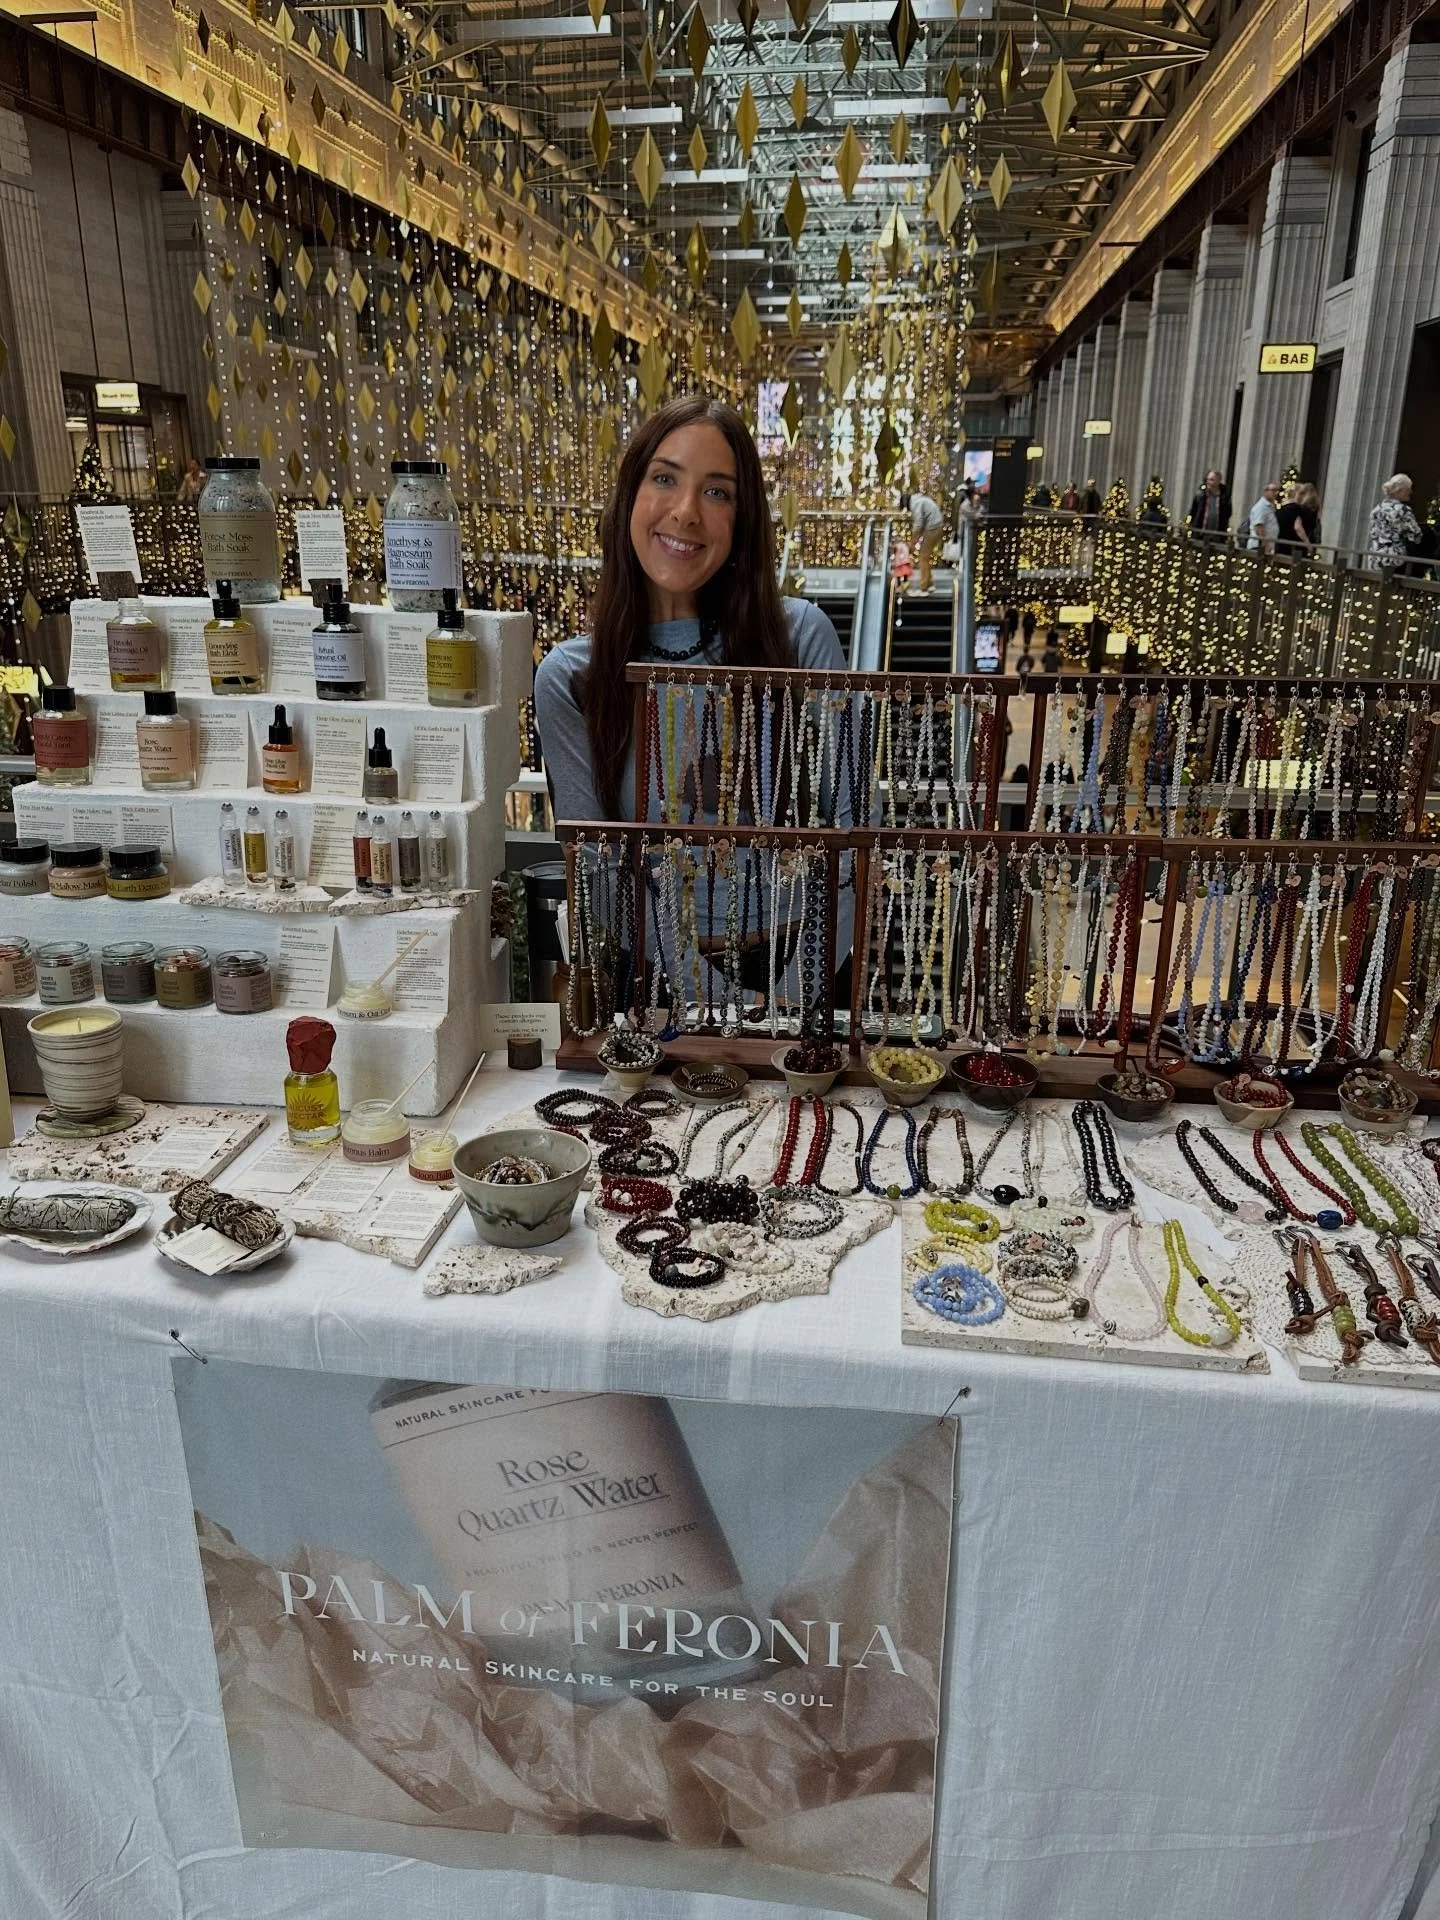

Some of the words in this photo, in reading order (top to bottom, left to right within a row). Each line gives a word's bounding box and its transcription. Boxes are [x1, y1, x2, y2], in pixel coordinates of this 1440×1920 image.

[226, 543, 250, 552] Soak
[229, 532, 254, 541] Moss
[389, 559, 405, 569] Bath
[406, 560, 430, 569] Soak
[368, 1147, 390, 1157] Balm
[395, 1409, 446, 1428] NATURAL
[448, 1390, 525, 1414] SKINCARE
[496, 1450, 590, 1488] Rose
[458, 1496, 565, 1542] Quartz
[569, 1472, 662, 1508] Water
[607, 1534, 651, 1549] NEVER
[653, 1521, 698, 1538] PERFECT
[596, 1571, 685, 1604] FERONIA
[276, 1569, 477, 1636] PALM
[499, 1606, 554, 1638] of
[571, 1600, 909, 1677] FERONIA
[352, 1648, 469, 1672] NATURAL
[485, 1660, 614, 1687] SKINCARE
[629, 1679, 679, 1695] FOR
[695, 1685, 747, 1702] THE
[763, 1690, 834, 1708] SOUL
